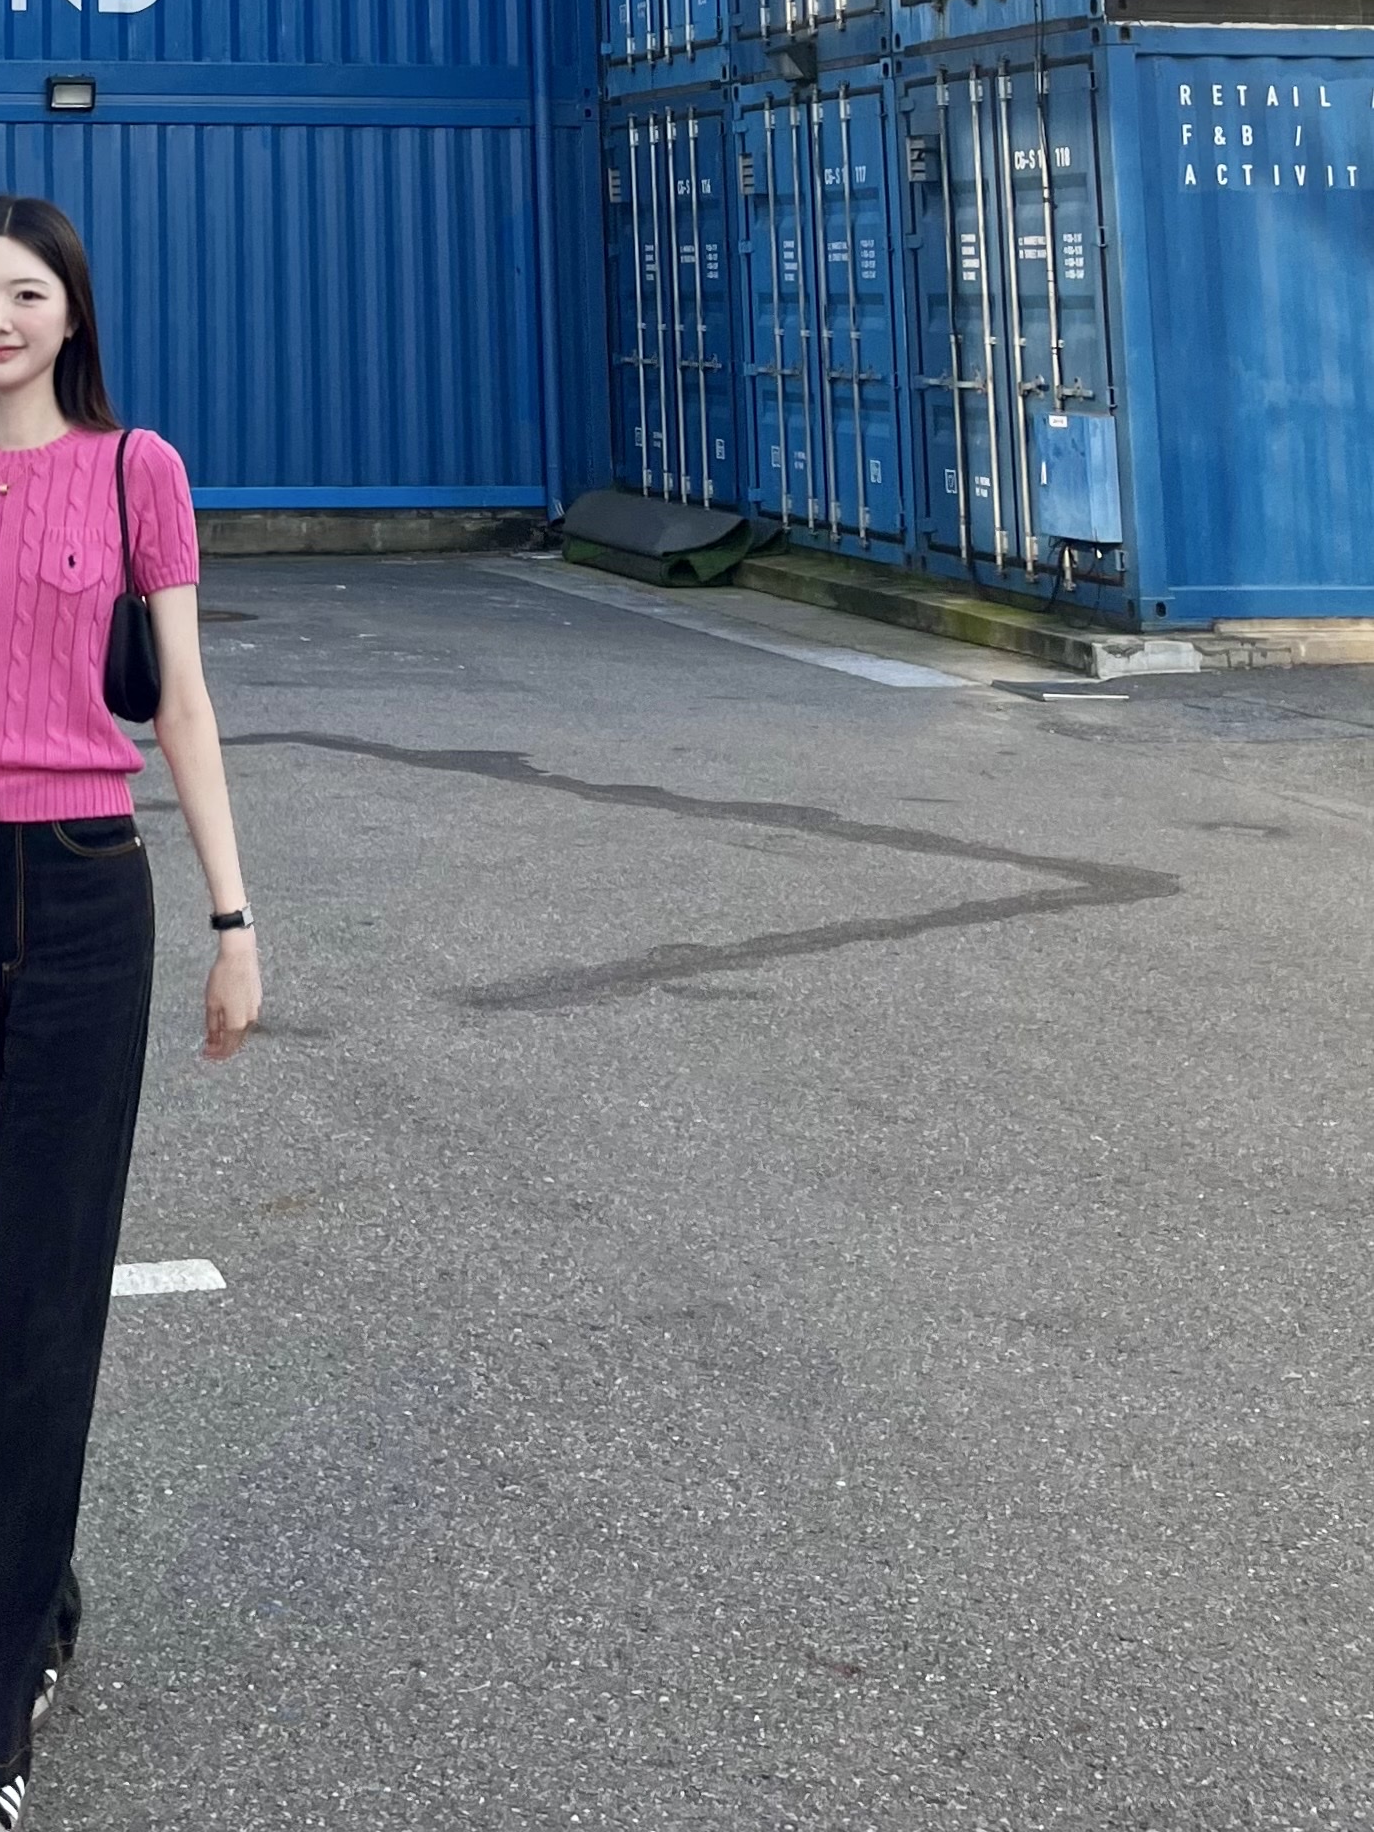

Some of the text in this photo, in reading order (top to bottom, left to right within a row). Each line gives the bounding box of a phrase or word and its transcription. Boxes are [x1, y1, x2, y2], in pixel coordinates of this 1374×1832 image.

[1179, 84, 1331, 107] RETAIL
[1182, 124, 1254, 146] F&B
[1185, 164, 1357, 187] ACTIVIT
